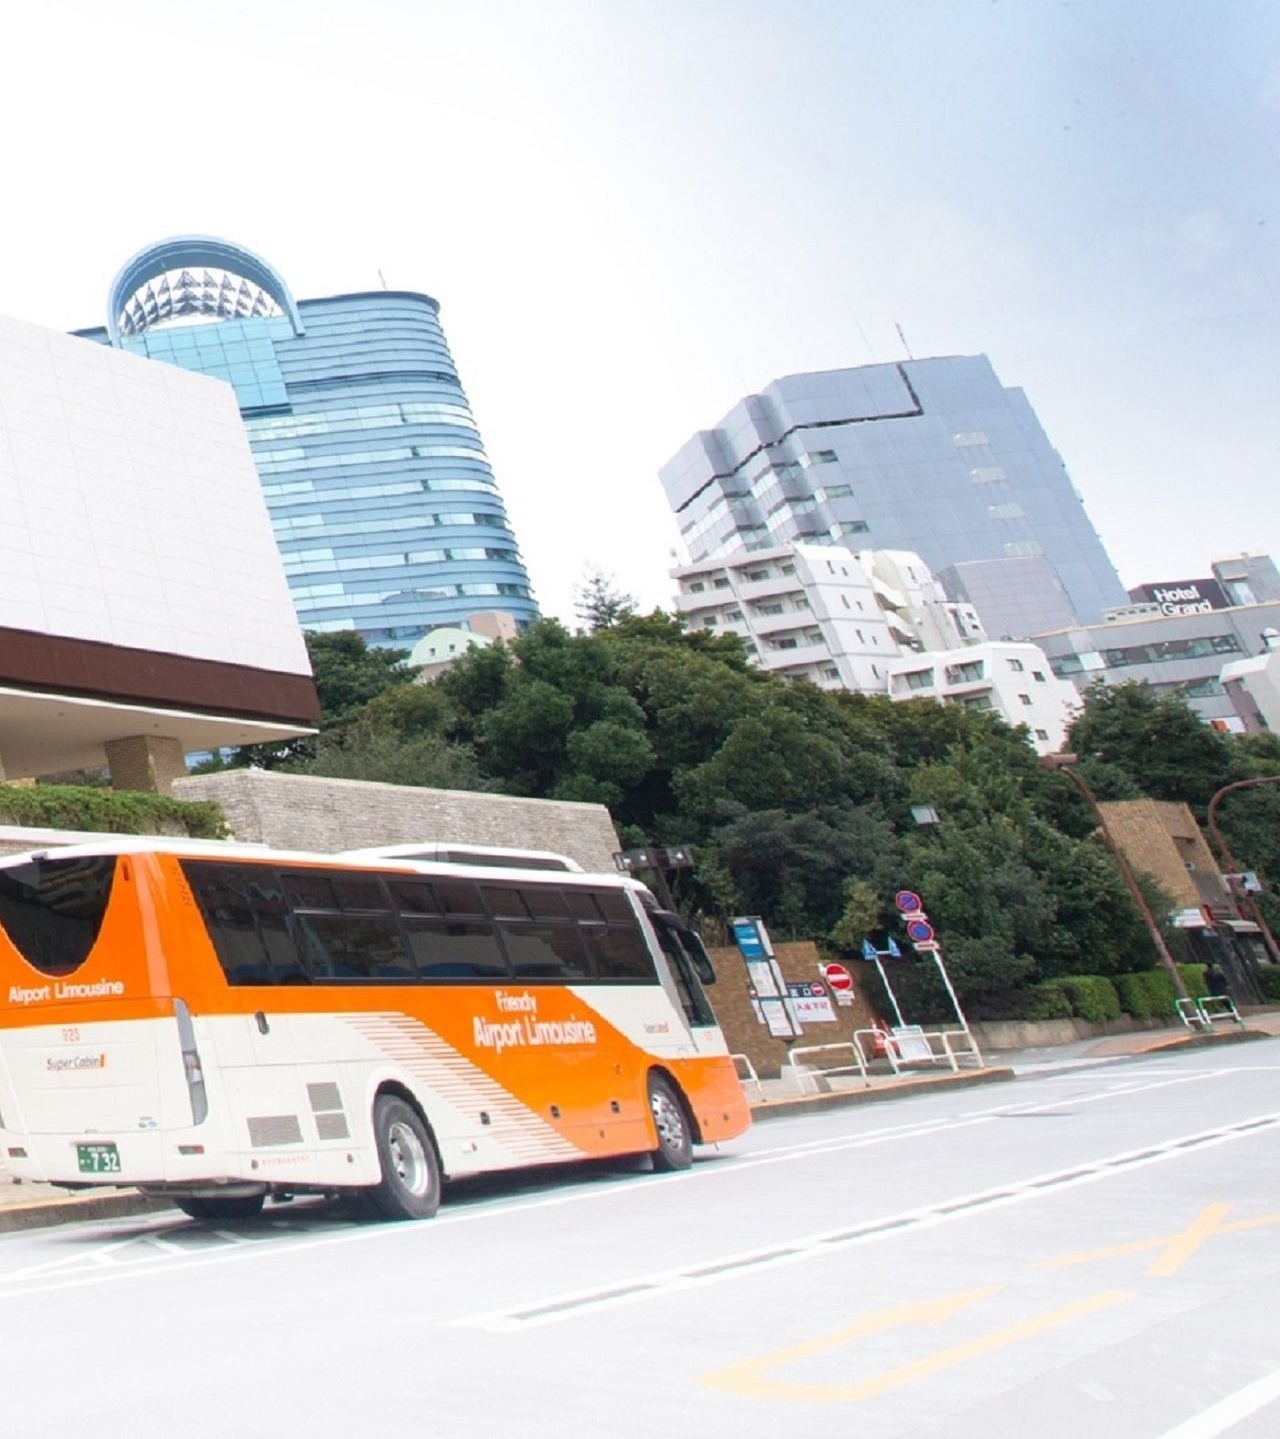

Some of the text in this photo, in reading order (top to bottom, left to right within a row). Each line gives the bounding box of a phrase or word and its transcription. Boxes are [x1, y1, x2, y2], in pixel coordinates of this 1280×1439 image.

[1153, 584, 1200, 602] Hotel
[1162, 599, 1213, 616] Grand
[8, 979, 125, 1005] Airport Limousine
[495, 990, 537, 1012] Friendly
[473, 1014, 597, 1054] Airport Limousine
[47, 1057, 72, 1072] Super
